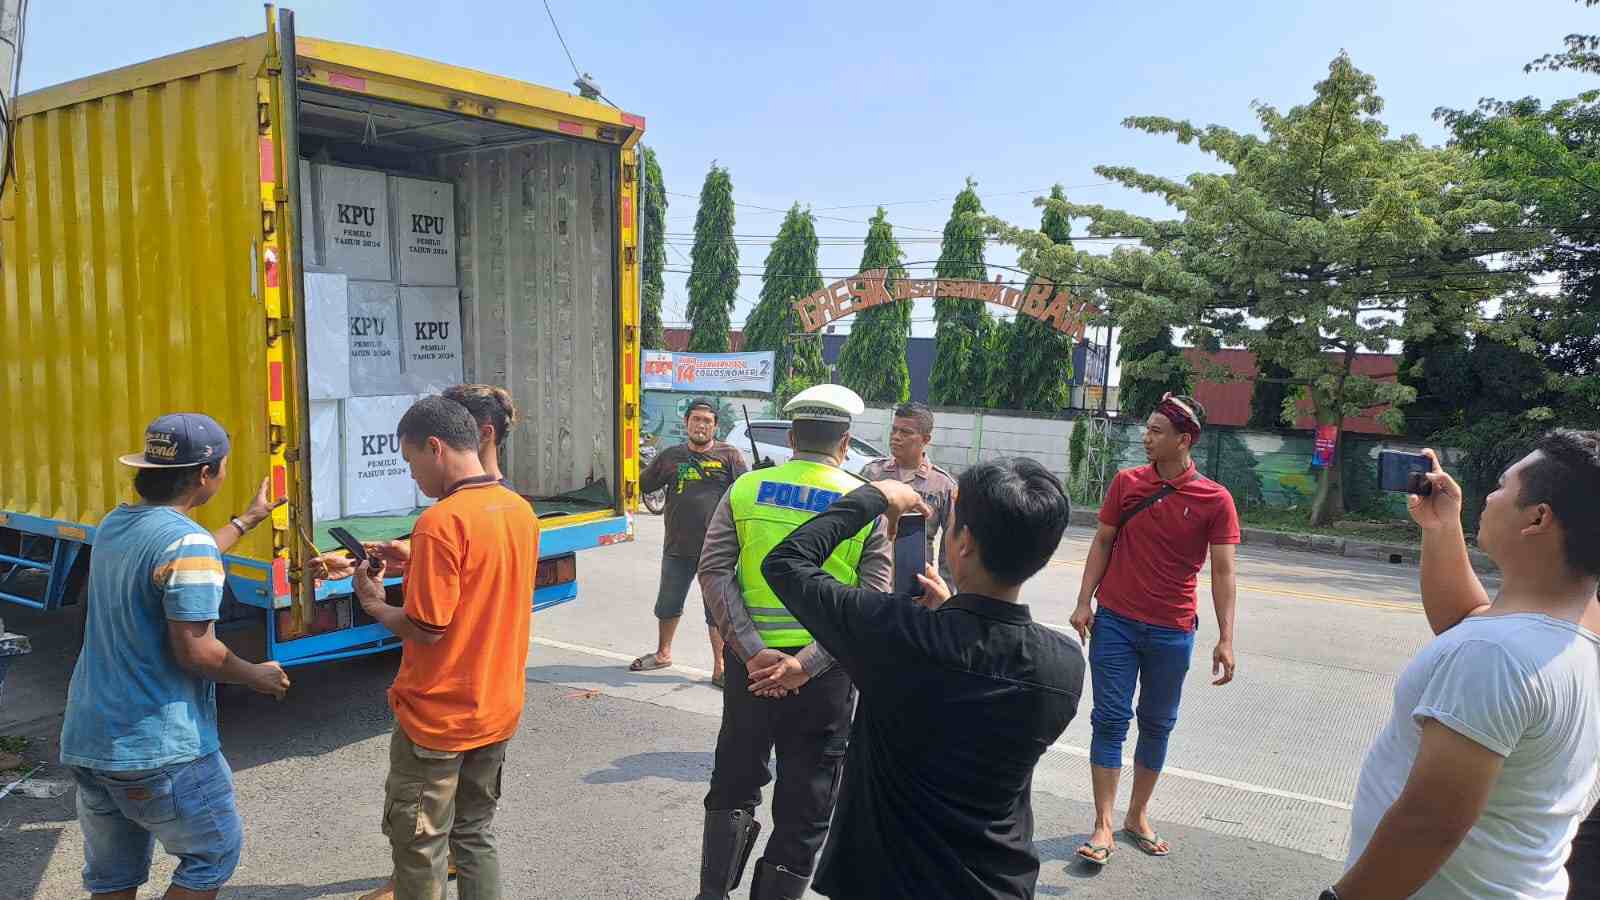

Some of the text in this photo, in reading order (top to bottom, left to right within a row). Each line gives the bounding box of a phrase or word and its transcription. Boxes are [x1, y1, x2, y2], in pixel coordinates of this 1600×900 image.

[337, 203, 376, 226] KPU
[411, 214, 445, 235] KPU
[343, 229, 372, 238] PEMILU
[335, 237, 382, 248] TAHUN 2024
[416, 237, 441, 246] PEMILU
[409, 246, 448, 255] TAHUN 2024
[792, 266, 893, 333] GRESIK
[351, 316, 385, 336] KPU
[414, 321, 450, 341] KPU
[420, 344, 446, 352] PEMILU
[412, 352, 454, 361] TAHUN 2024
[360, 433, 401, 456] KPU
[367, 458, 397, 468] PEMILU
[357, 468, 406, 479] TAHUN 2024
